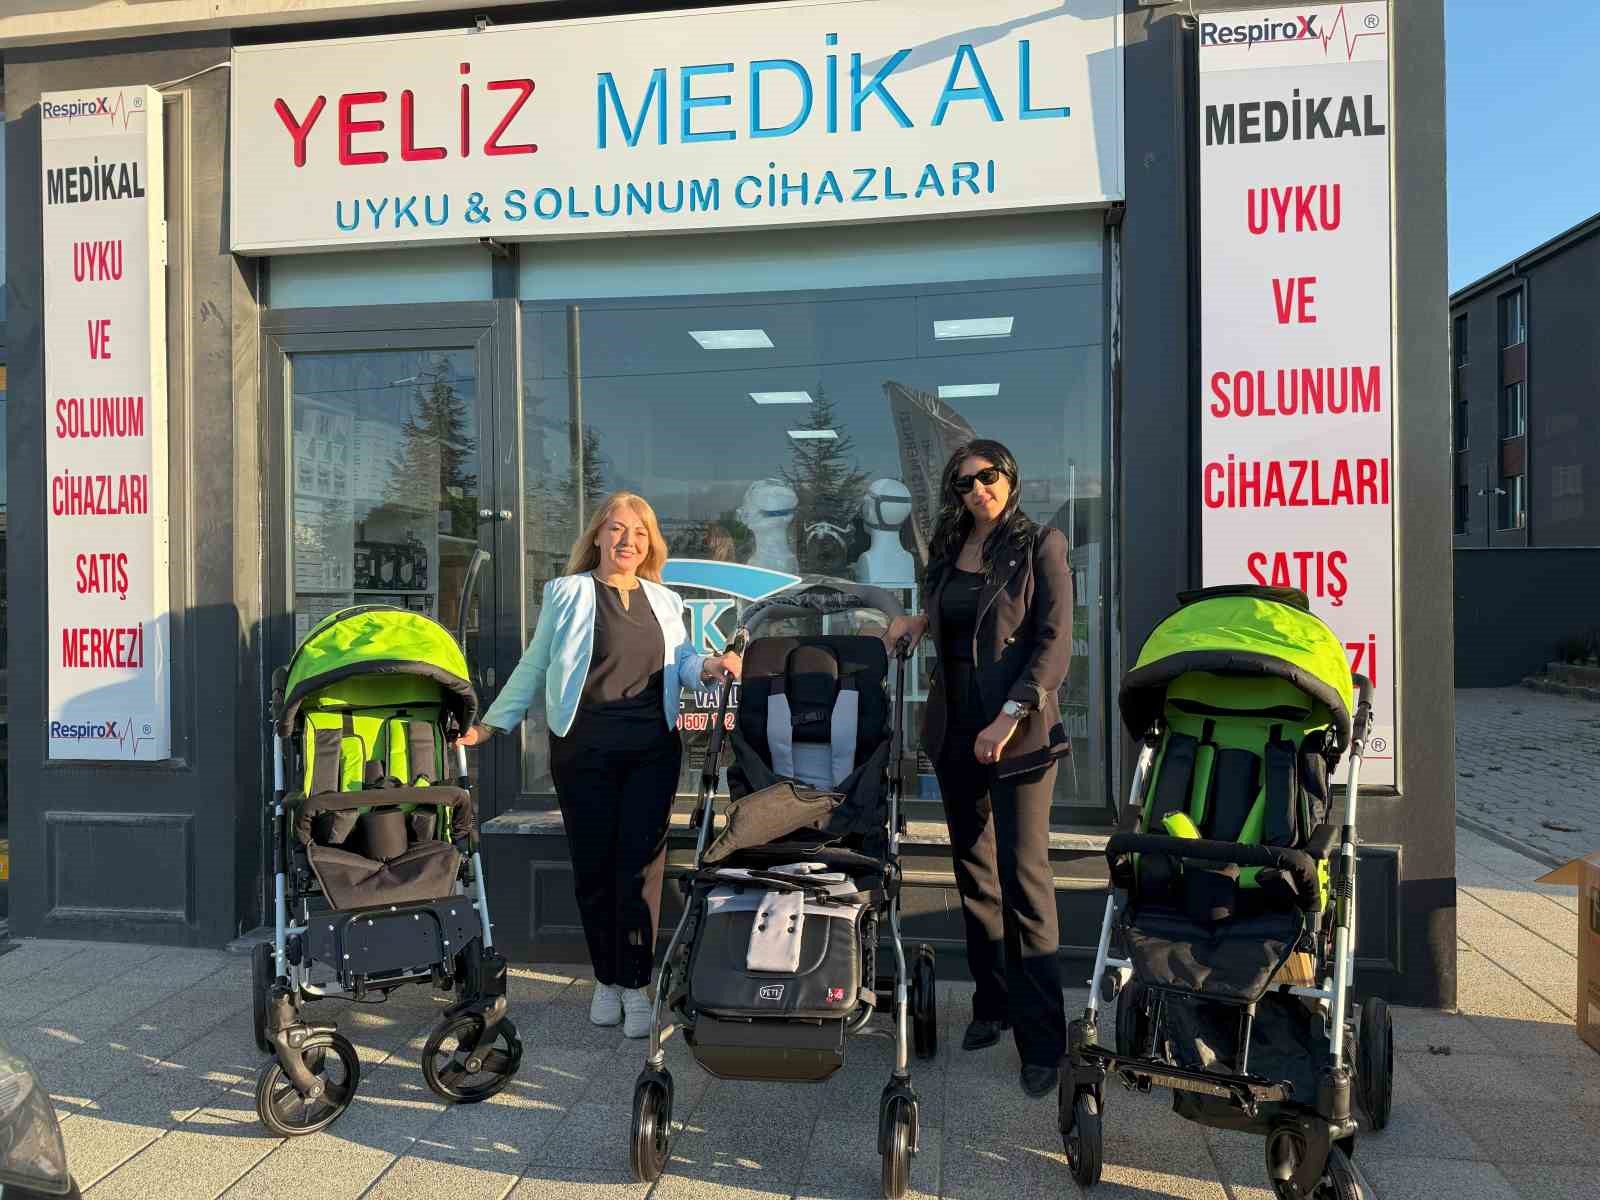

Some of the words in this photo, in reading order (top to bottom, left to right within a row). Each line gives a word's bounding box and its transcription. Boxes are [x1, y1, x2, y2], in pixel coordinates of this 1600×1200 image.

[1200, 14, 1317, 48] RespiroX
[42, 97, 109, 121] RespiroX
[274, 63, 538, 167] YELİZ
[597, 33, 1071, 149] MEDİKAL
[1205, 88, 1386, 146] MEDİKAL
[47, 156, 145, 205] MEDİKAL
[336, 194, 449, 231] UYKU
[465, 192, 490, 224] &
[506, 178, 720, 221] SOLUNUM
[735, 159, 995, 209] CİHAZLARI
[1247, 183, 1341, 235] UYKU
[73, 239, 123, 282] UYKU
[1272, 276, 1317, 325] VE
[88, 319, 111, 360] VE
[1210, 366, 1381, 418] SOLUNUM
[56, 396, 144, 439] SOLUNUM
[52, 469, 148, 516] CİHAZLARI
[1203, 453, 1389, 509] CİHAZLARI
[76, 552, 129, 600] SATIŞ
[1247, 550, 1348, 606] SATIŞ
[62, 622, 144, 668] MERKEZİ
[51, 721, 117, 743] RespiroX
